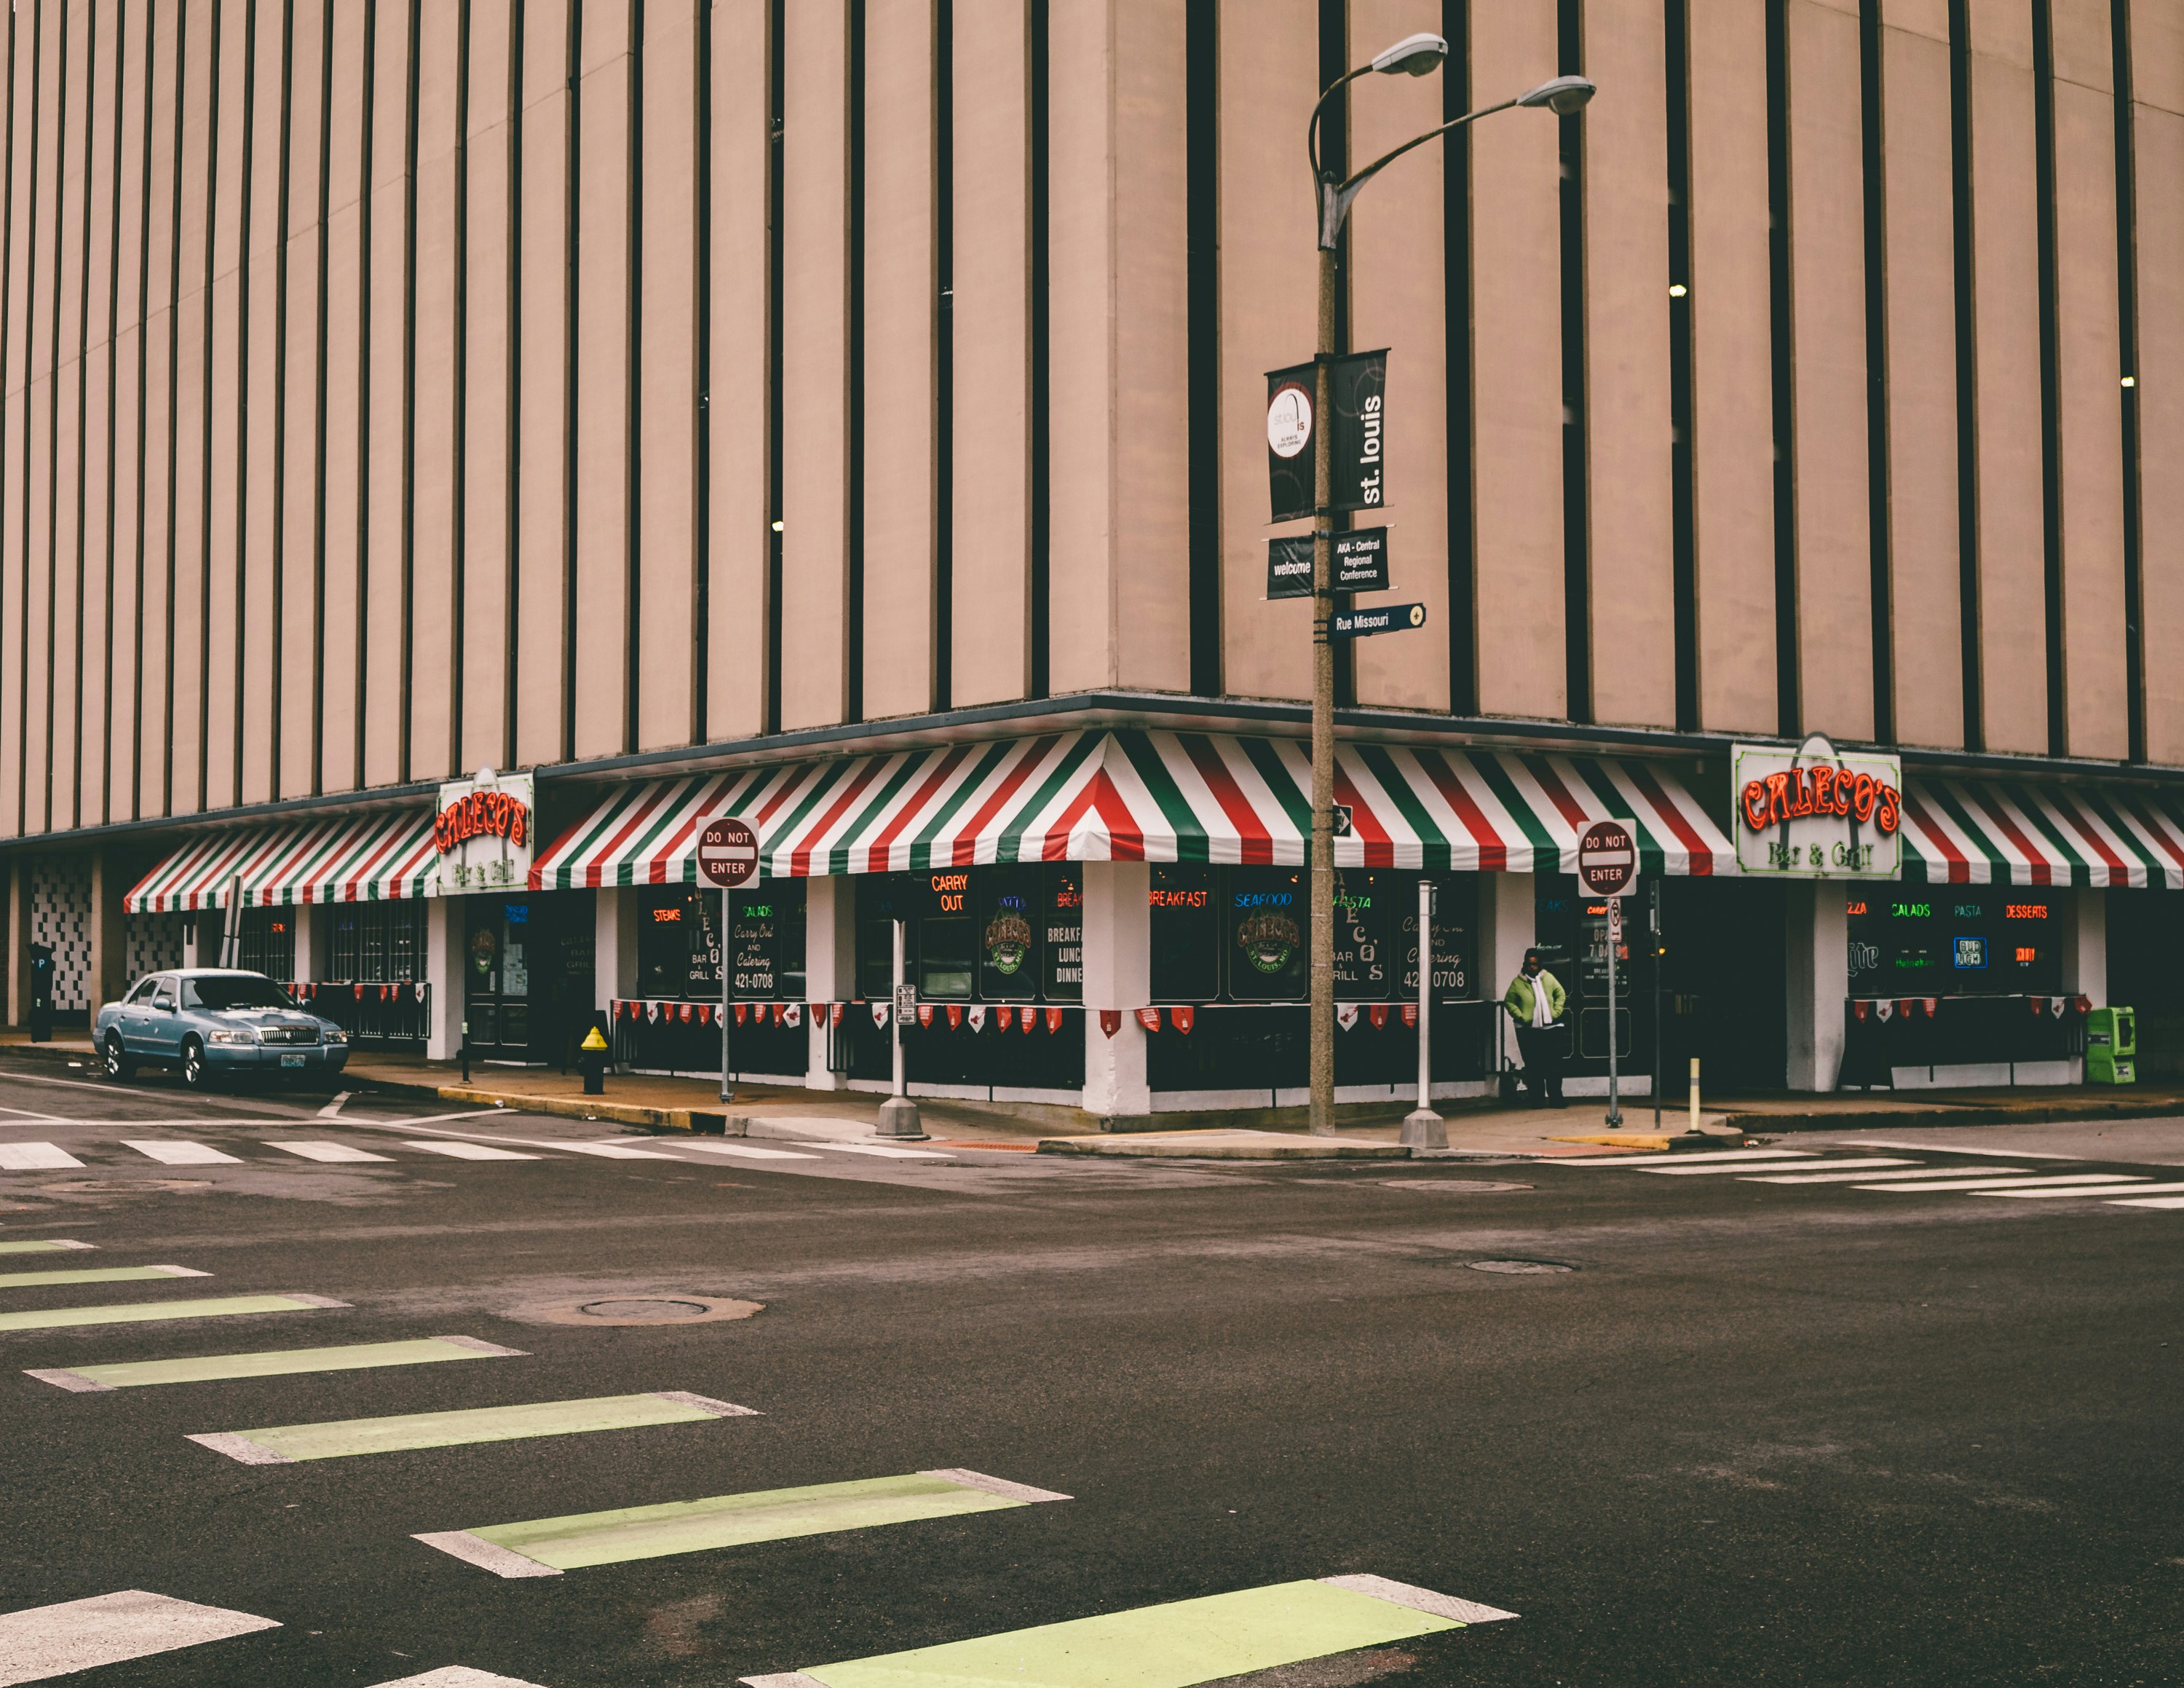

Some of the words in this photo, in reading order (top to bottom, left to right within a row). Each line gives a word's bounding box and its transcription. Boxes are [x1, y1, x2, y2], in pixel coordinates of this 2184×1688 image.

[1361, 395, 1380, 464] louis
[1278, 440, 1301, 449] EXPLORING
[1361, 470, 1380, 504] st.
[1337, 543, 1350, 553] AKA
[1356, 540, 1380, 552] Central
[1274, 561, 1310, 575] welcome
[1344, 555, 1372, 568] Regional
[1340, 569, 1377, 580] Conference
[1337, 618, 1352, 631] Rue
[1354, 613, 1388, 628] Missouri
[1741, 766, 1900, 835] CALECO'S
[435, 792, 526, 855] CALECO'S
[707, 832, 721, 843] DO
[728, 832, 749, 843] NOT
[1586, 837, 1599, 848] DO
[1605, 835, 1626, 848] NOT
[1768, 842, 1803, 865] Bar
[1809, 843, 1823, 866] &
[1832, 842, 1874, 867] Grill
[711, 863, 745, 874] ENTER
[1591, 869, 1622, 881] ENTER
[932, 875, 968, 891] CARRY
[941, 894, 963, 911] OUT
[1057, 893, 1083, 907] BREAK
[1149, 891, 1207, 907] BREAKFAST
[1235, 893, 1292, 907] SEAFOOD
[1538, 898, 1568, 912] EAKS
[654, 909, 681, 922] STEAKS
[743, 905, 773, 918] SALADS
[1847, 902, 1867, 915] ZZA
[1891, 904, 1931, 917] SALADS
[1955, 906, 1982, 918] PASTA
[2006, 904, 2047, 919] DESSERTS
[735, 925, 758, 942] Carry
[759, 923, 774, 938] Out
[1238, 916, 1300, 947] CALECO'S
[1402, 916, 1440, 937] Cay
[986, 918, 1031, 950] CALECO'S
[1048, 928, 1083, 942] BREAKF
[1960, 941, 1982, 953] BUD
[692, 955, 707, 963] BAR
[737, 953, 771, 971] Catering
[1016, 950, 1022, 963] MO
[1059, 948, 1083, 962] LUNC
[1279, 950, 1288, 961] MO
[1407, 947, 1461, 969] Cering
[1848, 942, 1878, 977] ite
[1896, 958, 1934, 967] Heineken
[689, 971, 709, 979] GRILL
[735, 973, 773, 988] 421-0708
[1056, 968, 1083, 982] DINNE
[1333, 971, 1358, 980] RILL
[1404, 971, 1464, 987] 420708
